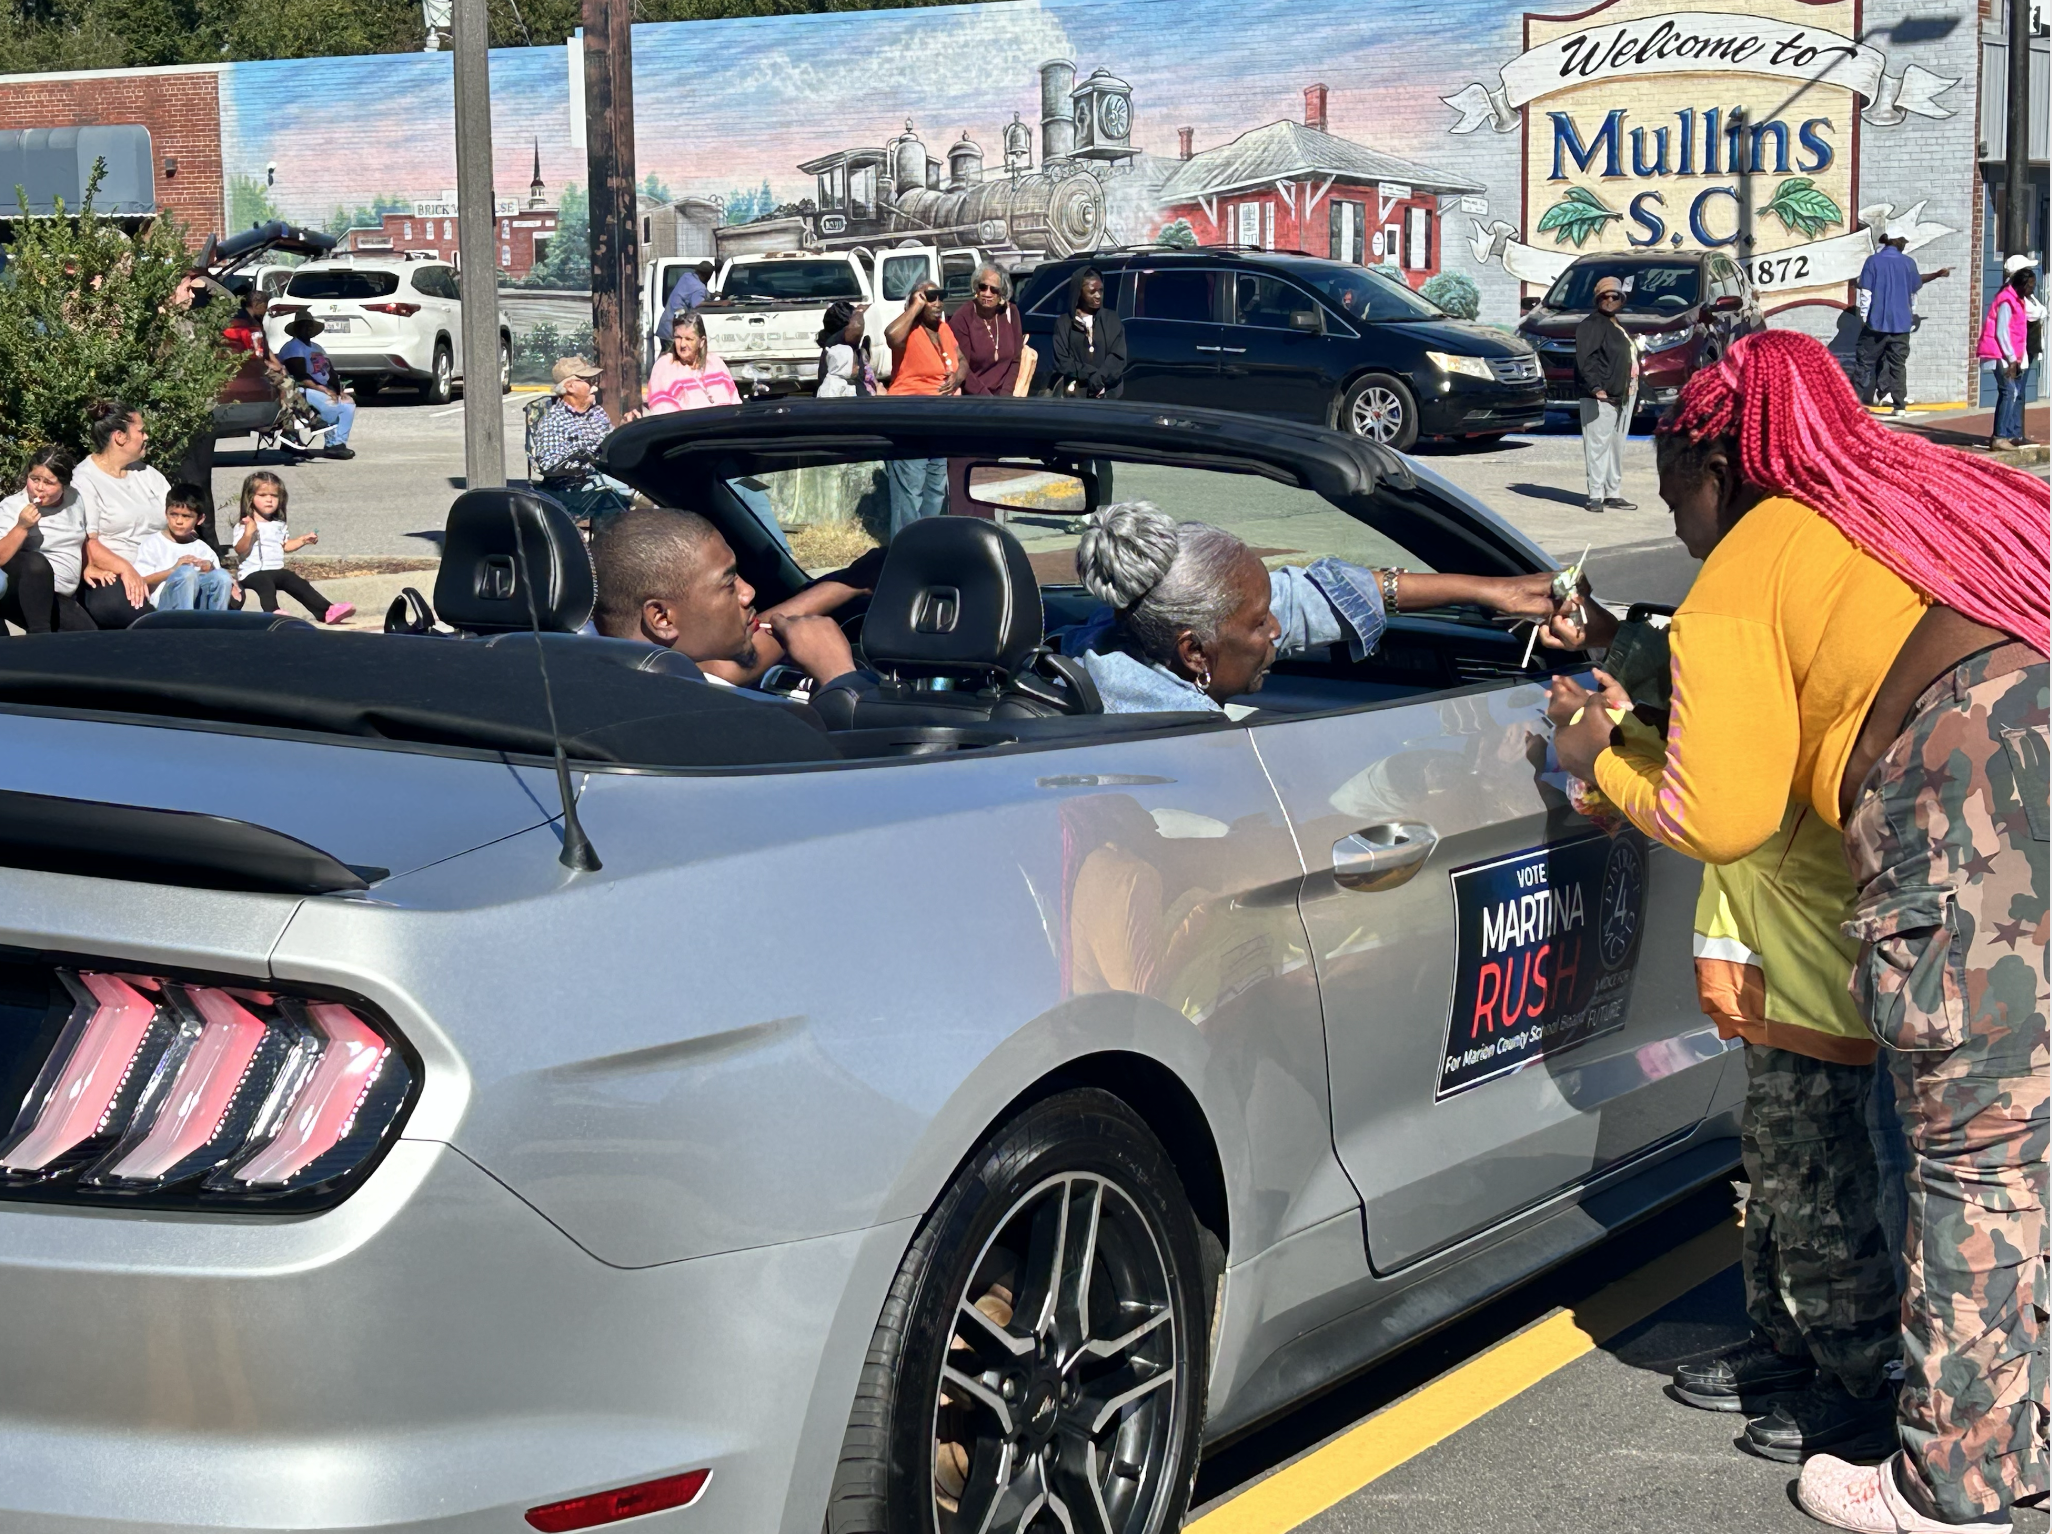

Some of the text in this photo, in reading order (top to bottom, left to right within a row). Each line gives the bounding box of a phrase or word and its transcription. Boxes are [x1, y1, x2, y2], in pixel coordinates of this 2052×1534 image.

[1559, 20, 1858, 78] Welcome to
[1545, 104, 1835, 181] Mullins
[417, 203, 450, 217] BRICK
[1626, 186, 1754, 249] S.C.
[1746, 255, 1810, 285] 1872
[708, 332, 820, 344] HEVROLET
[1516, 863, 1547, 888] VOTE
[1614, 872, 1628, 926] 4
[1481, 881, 1585, 958] MARTINA
[1471, 934, 1582, 1039] RUSH
[1444, 1055, 1462, 1074] For
[1462, 1043, 1496, 1067] Marion
[1496, 1031, 1529, 1055] County
[1528, 1015, 1560, 1043] School
